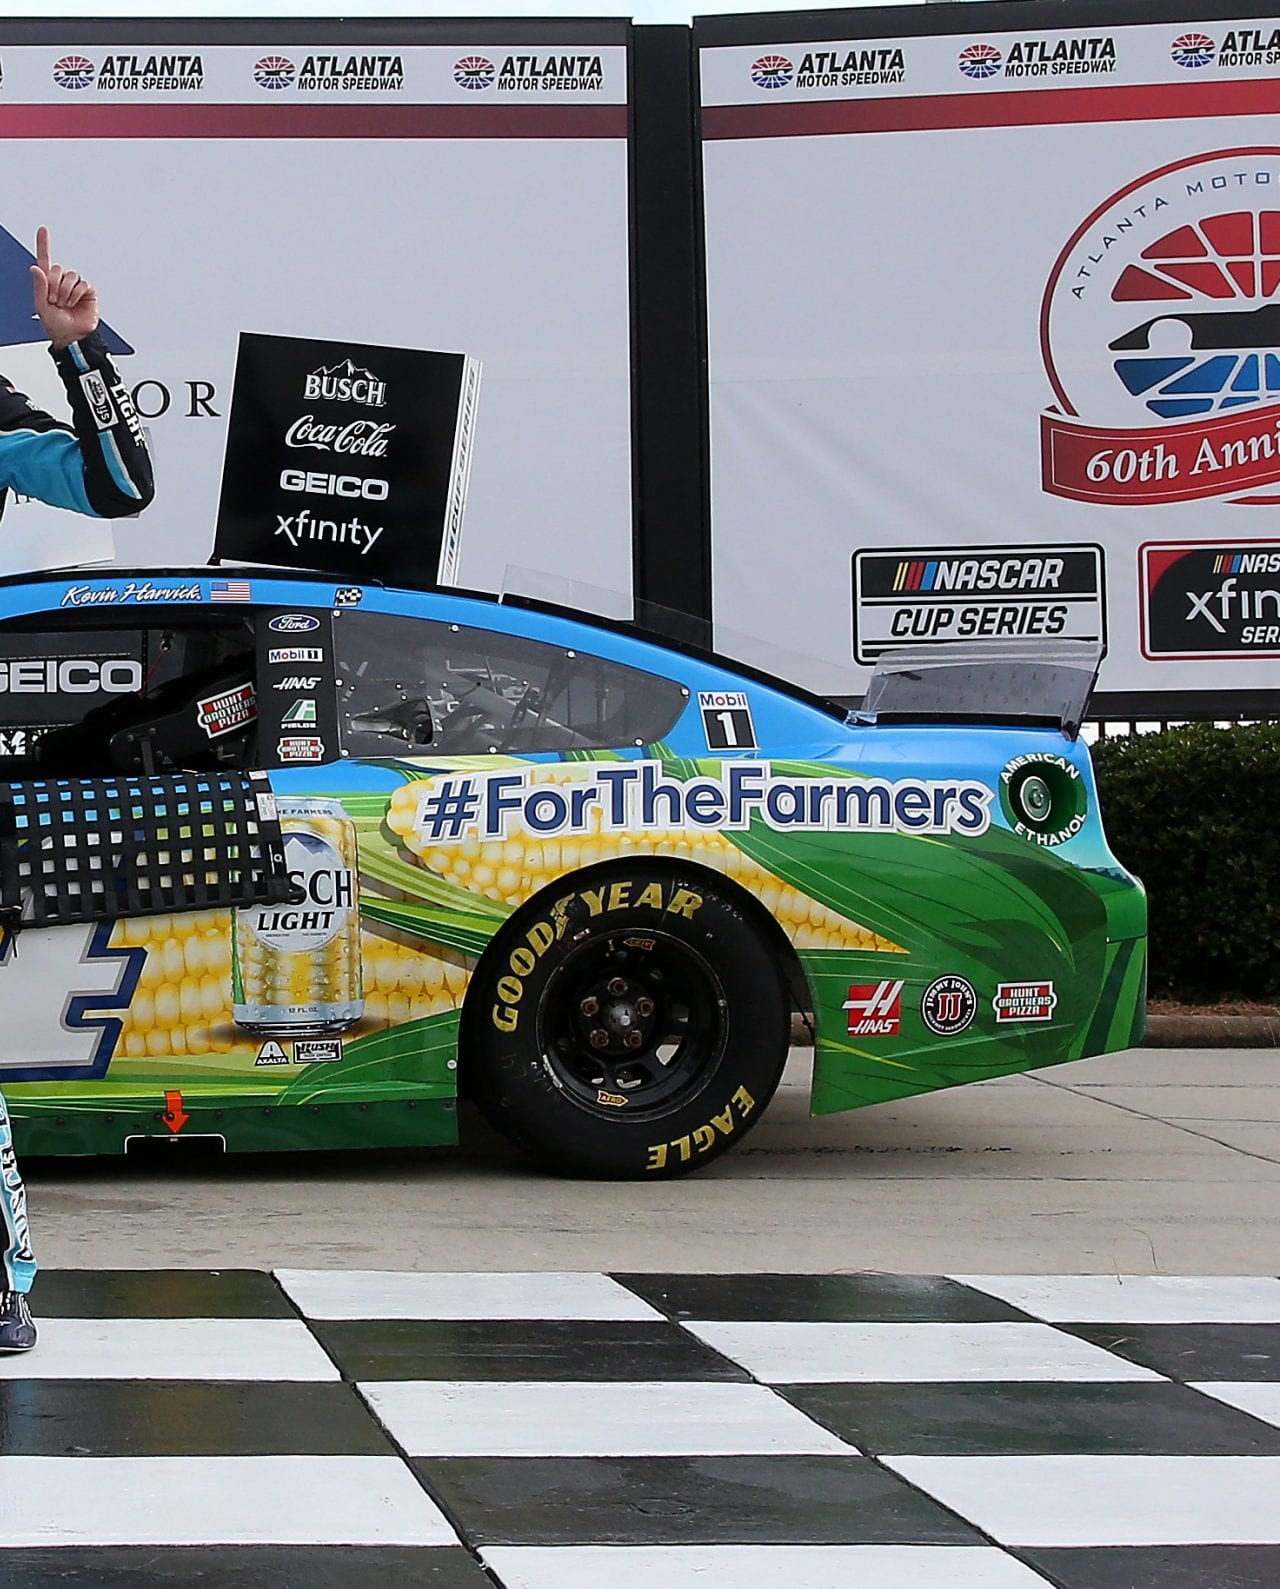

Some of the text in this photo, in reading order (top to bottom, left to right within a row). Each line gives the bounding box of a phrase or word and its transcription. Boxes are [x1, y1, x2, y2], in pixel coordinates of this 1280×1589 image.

[1006, 38, 1115, 64] ATLANTA
[1220, 29, 1280, 53] ATLA
[100, 56, 203, 76] ATLANTA
[301, 56, 403, 76] ATLANTA
[501, 56, 602, 76] ATLANTA
[798, 49, 904, 74] ATLANTA
[1005, 58, 1115, 78] MOTOR SPEEDWAY
[1219, 52, 1262, 67] MOTOR
[97, 77, 203, 90] MOTOR SPEEDWAY
[298, 77, 403, 90] MOTOR SPEEDWAY
[498, 77, 602, 90] MOTOR SPEEDWAY
[796, 69, 904, 88] MOTOR SPEEDWAY
[1072, 172, 1270, 300] ATLANTA MOTO
[304, 374, 387, 407] BUSCH
[110, 382, 146, 447] LIGHT
[285, 415, 396, 457] Coca-Cola
[1086, 445, 1179, 483] 60th
[280, 469, 389, 501] GEICO
[274, 509, 384, 555] xfinity
[1240, 554, 1280, 573] NAS
[933, 559, 1064, 590] NASCAR
[61, 586, 119, 606] Kevin
[1185, 578, 1280, 633] xfin
[279, 617, 310, 630] Ford
[891, 605, 1068, 637] CUP SERIES
[1240, 626, 1280, 643] SER
[271, 650, 304, 661] Mobil
[273, 677, 321, 690] HAAS
[213, 692, 242, 711] HUNT
[700, 694, 746, 706] Mobil
[218, 709, 249, 728] PIZZA
[717, 712, 737, 745] 1
[1000, 753, 1079, 784] AMERICAN
[423, 768, 986, 842] #ForTheFarmers
[1015, 814, 1086, 845] ETHANOL
[287, 869, 353, 908] SCH
[257, 911, 334, 931] LIGHT
[492, 881, 703, 1032] GOODYEAR
[999, 996, 1052, 1007] BROTHERS
[1010, 988, 1040, 997] HUNT
[937, 993, 962, 1020] JJ
[1009, 1006, 1040, 1016] PIZZA
[848, 1019, 900, 1034] HAAS
[646, 1085, 755, 1169] EAGLE
